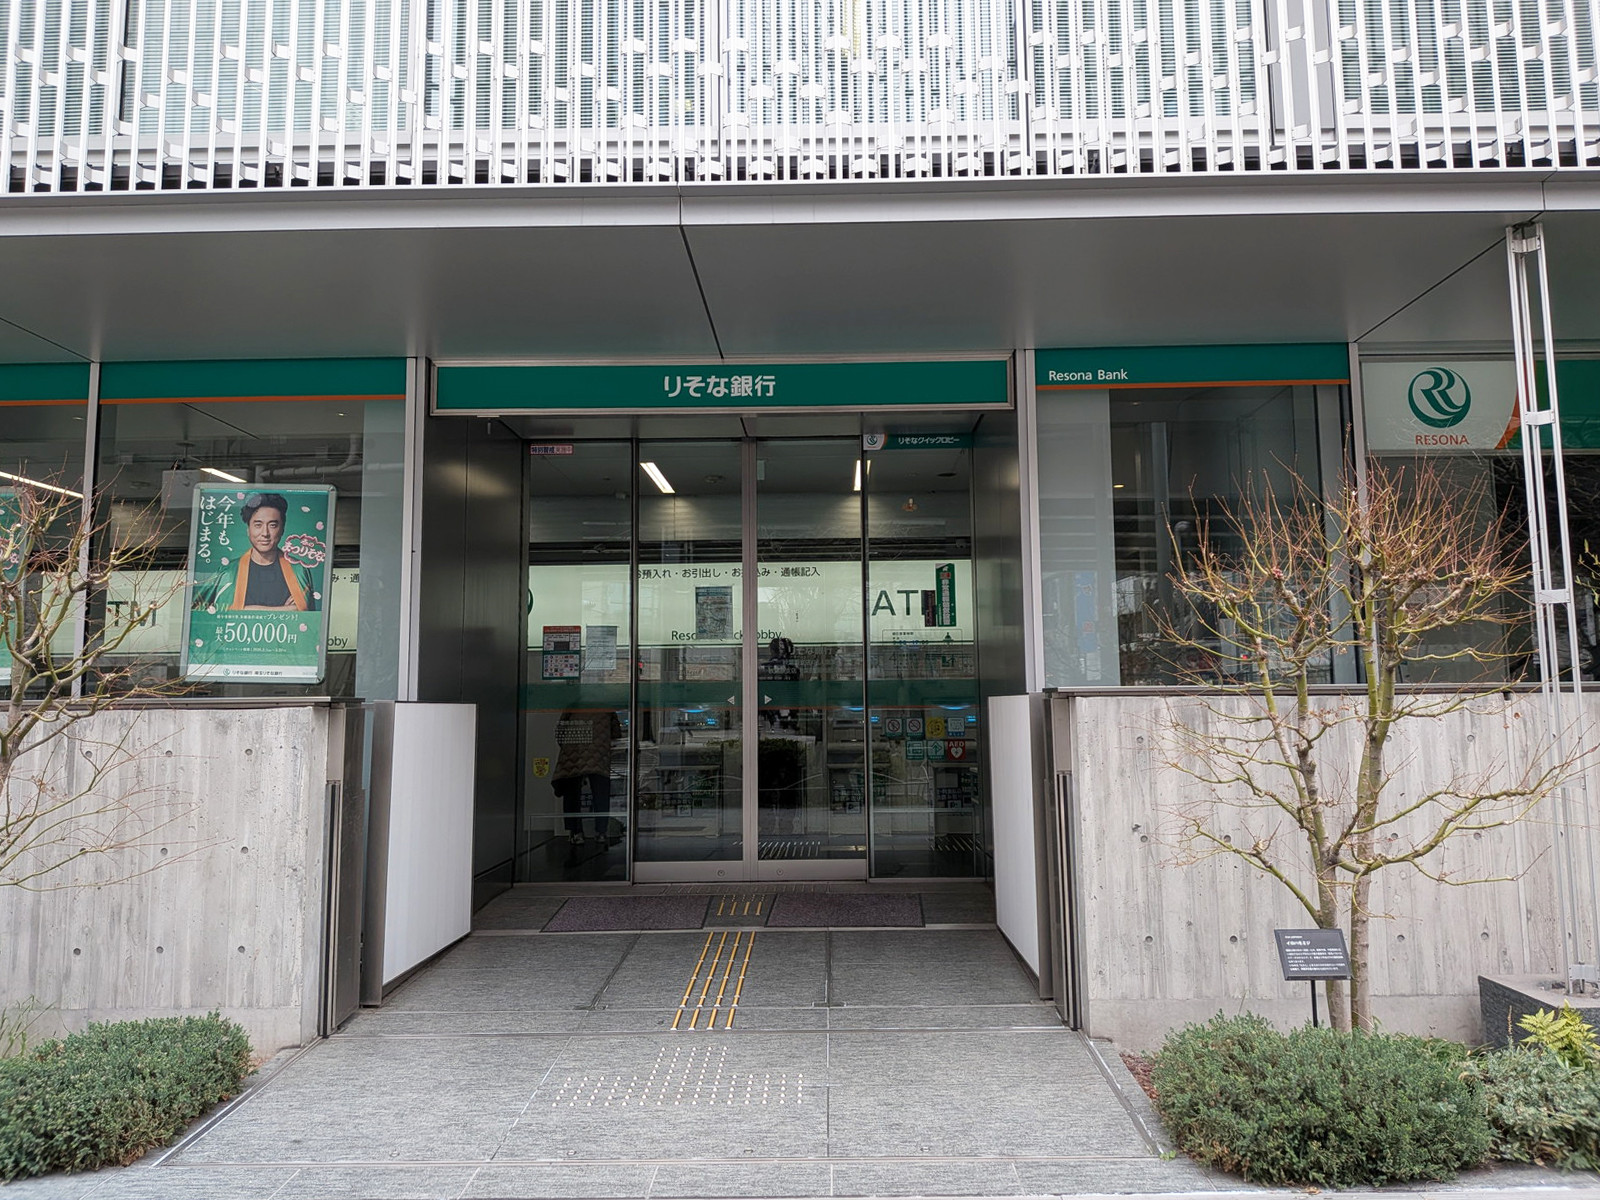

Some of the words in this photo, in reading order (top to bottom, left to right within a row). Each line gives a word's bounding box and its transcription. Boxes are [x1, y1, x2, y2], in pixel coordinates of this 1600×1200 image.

[1048, 370, 1093, 381] Resona
[1098, 368, 1129, 380] Bank
[663, 375, 776, 397] りそな銀行
[898, 436, 960, 445] りそなクイックロビー
[1415, 434, 1470, 446] RESONA
[197, 495, 216, 564] はじまる。
[216, 495, 236, 552] 今年も、
[281, 541, 326, 562] まつりそな
[871, 590, 928, 616] AT
[224, 622, 297, 644] 50,000円
[949, 740, 965, 748] AED
